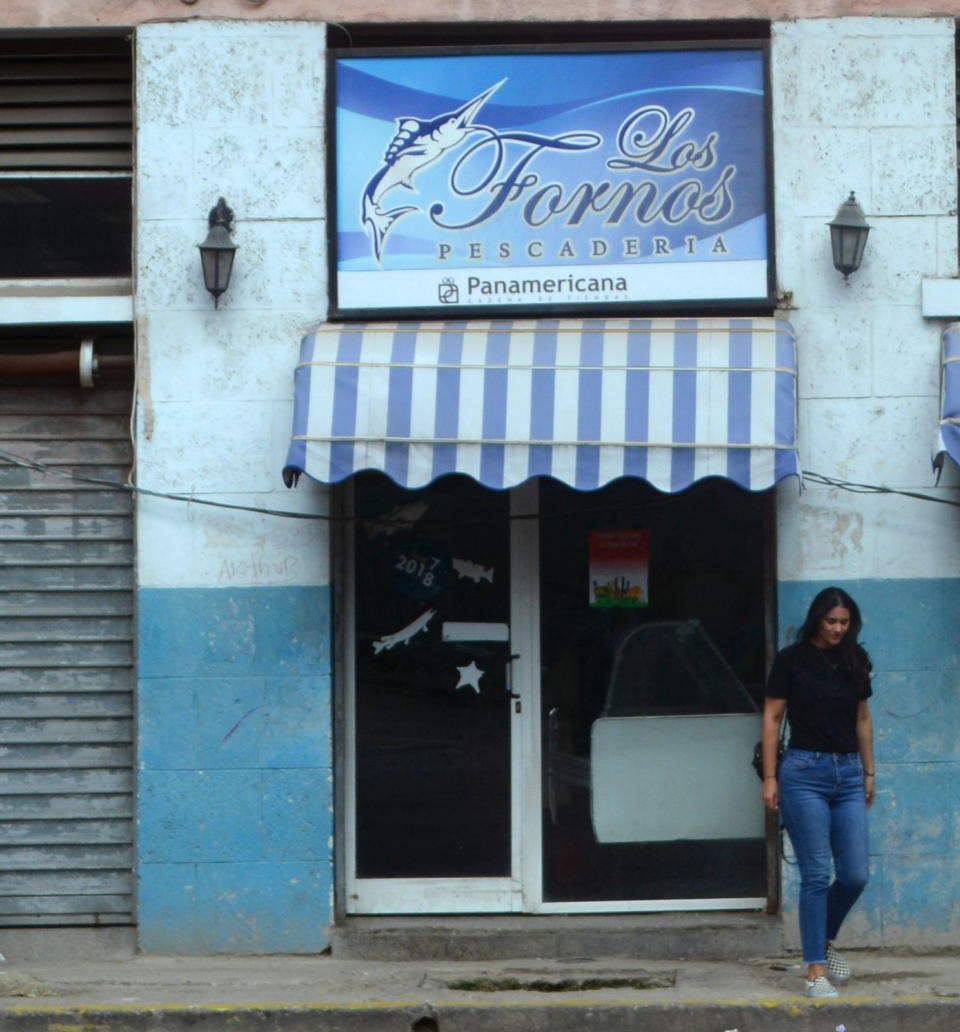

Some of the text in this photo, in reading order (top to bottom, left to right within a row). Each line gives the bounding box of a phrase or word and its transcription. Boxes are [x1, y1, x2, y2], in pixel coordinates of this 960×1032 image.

[607, 104, 720, 172] Los
[428, 124, 737, 231] Fornos
[438, 235, 730, 261] PESCADERIA
[467, 274, 628, 295] Panamericana
